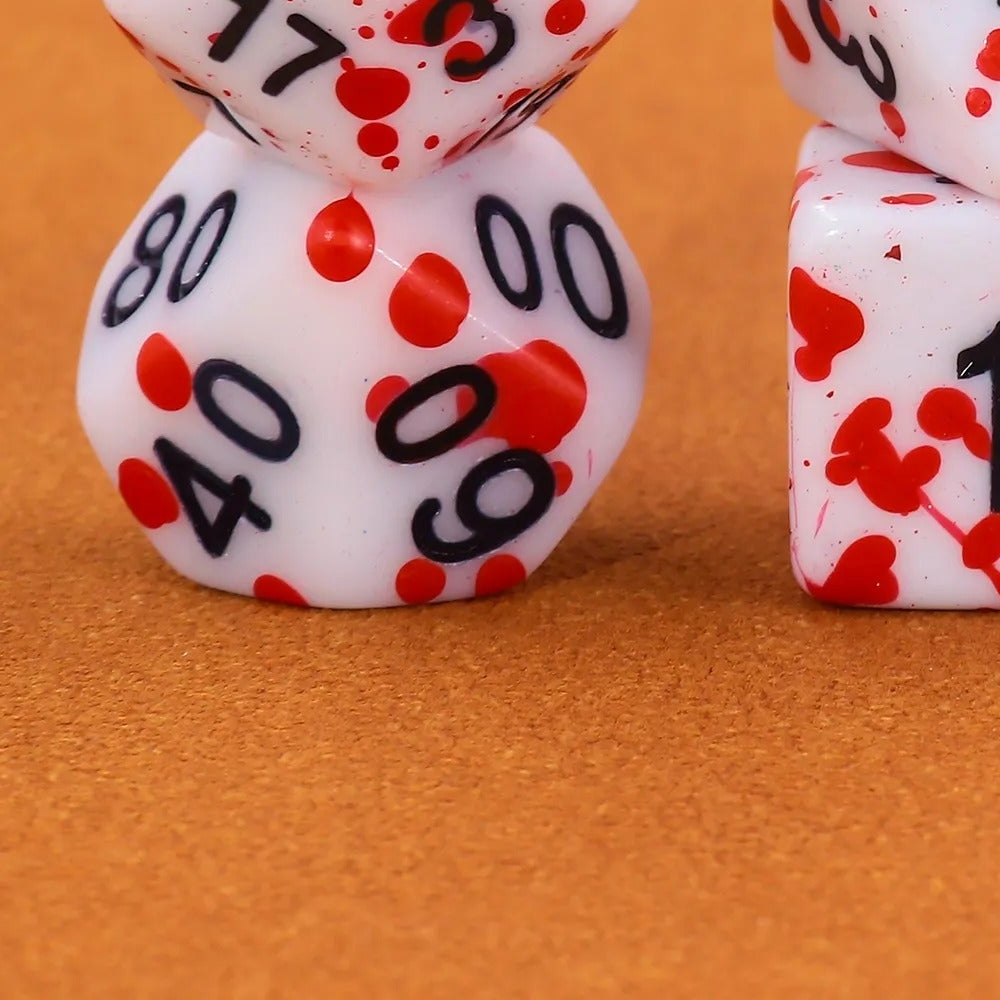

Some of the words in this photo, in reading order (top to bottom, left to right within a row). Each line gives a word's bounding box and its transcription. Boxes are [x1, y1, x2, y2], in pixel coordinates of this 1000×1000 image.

[101, 189, 238, 329] 80
[473, 193, 630, 341] 00
[152, 358, 301, 560] 40
